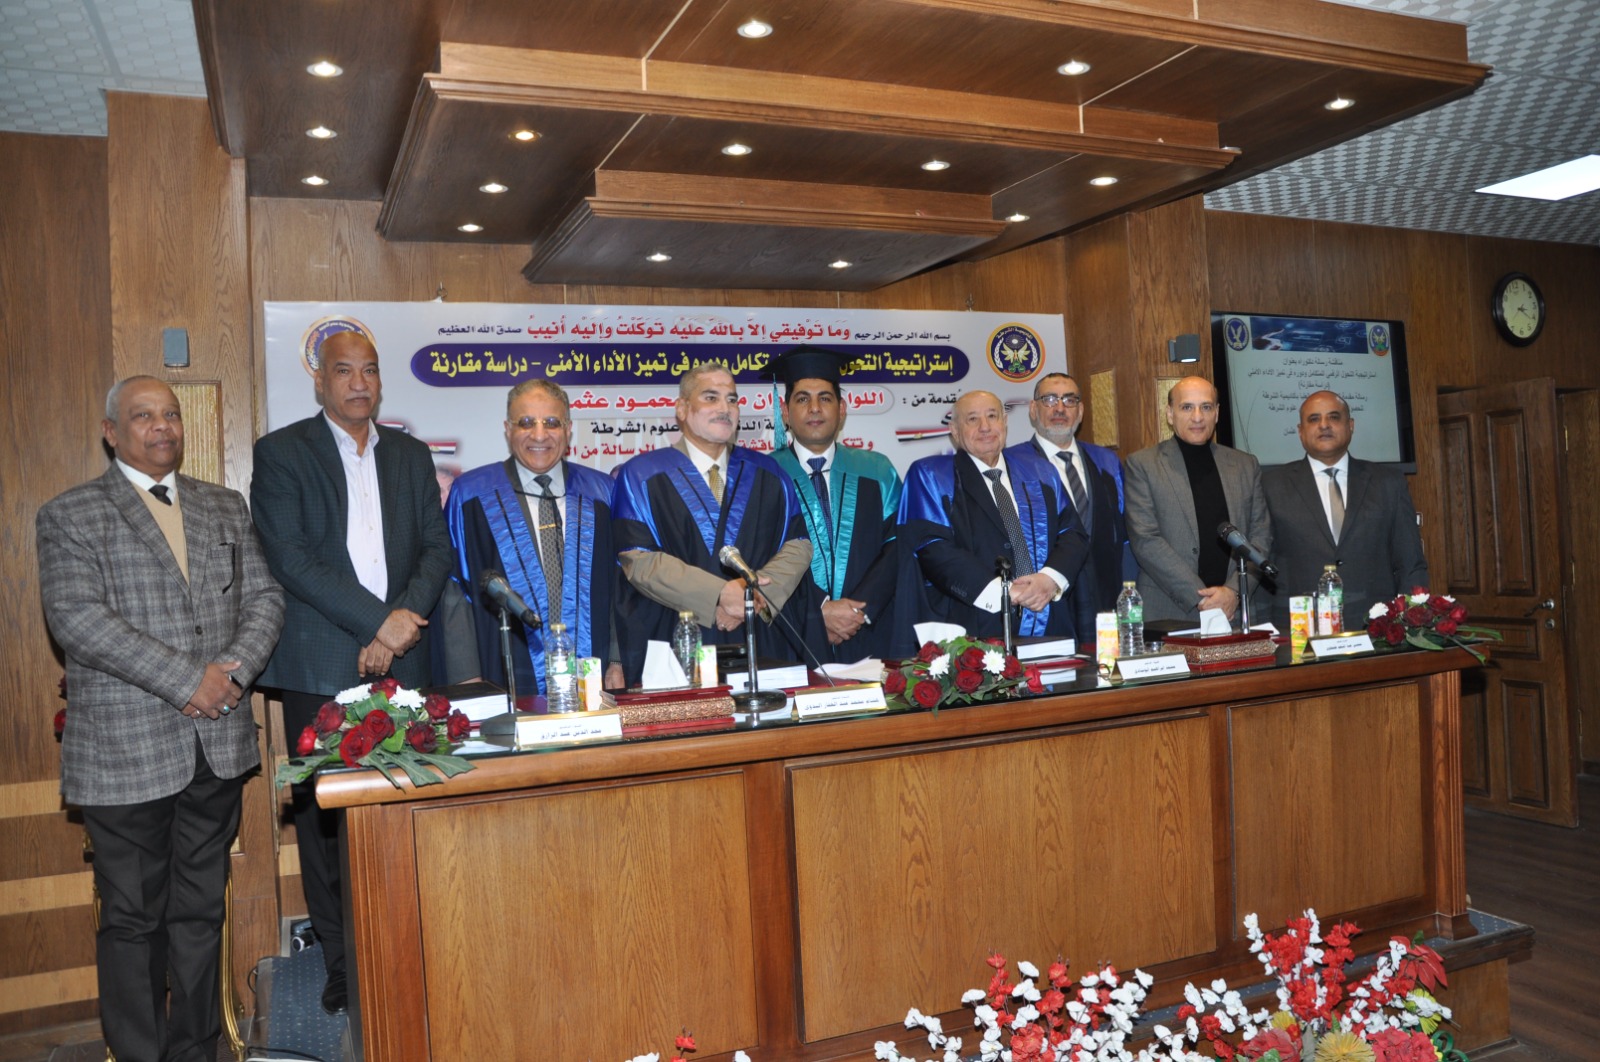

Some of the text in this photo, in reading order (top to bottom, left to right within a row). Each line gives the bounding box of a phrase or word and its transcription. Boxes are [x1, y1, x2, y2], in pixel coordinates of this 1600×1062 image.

[438, 324, 474, 336] العظيم
[478, 324, 494, 334] الله
[855, 331, 884, 341] الرحيم
[920, 332, 932, 340] الله
[934, 332, 951, 340] بسم
[430, 351, 482, 378] مقارنة
[484, 351, 528, 376] دراسة
[570, 390, 676, 412] حمود عثم
[848, 392, 884, 408] اللوا
[912, 394, 926, 407] من
[928, 392, 957, 404] قدمة
[590, 420, 680, 436] علوم الشرطة
[580, 446, 598, 459] من
